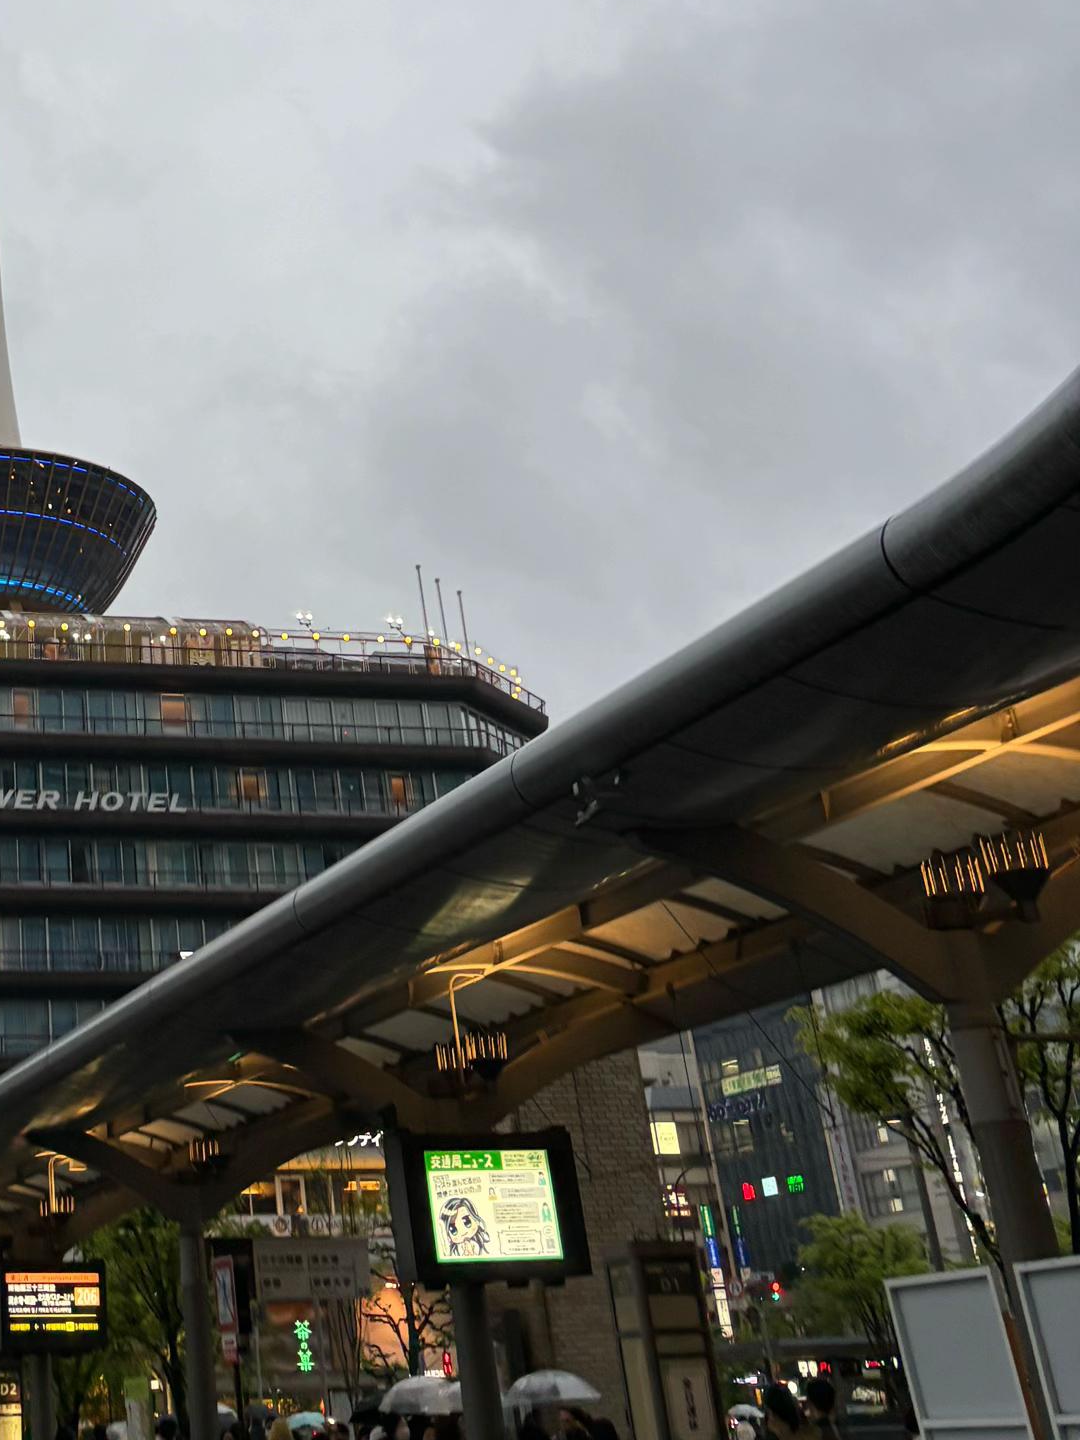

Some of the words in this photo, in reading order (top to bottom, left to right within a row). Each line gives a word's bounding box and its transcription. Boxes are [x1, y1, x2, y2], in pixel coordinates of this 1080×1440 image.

[74, 791, 188, 813] HOTEL
[430, 1153, 494, 1169] 交通局ニュース
[76, 1289, 97, 1304] 206
[0, 1382, 17, 1396] D2
